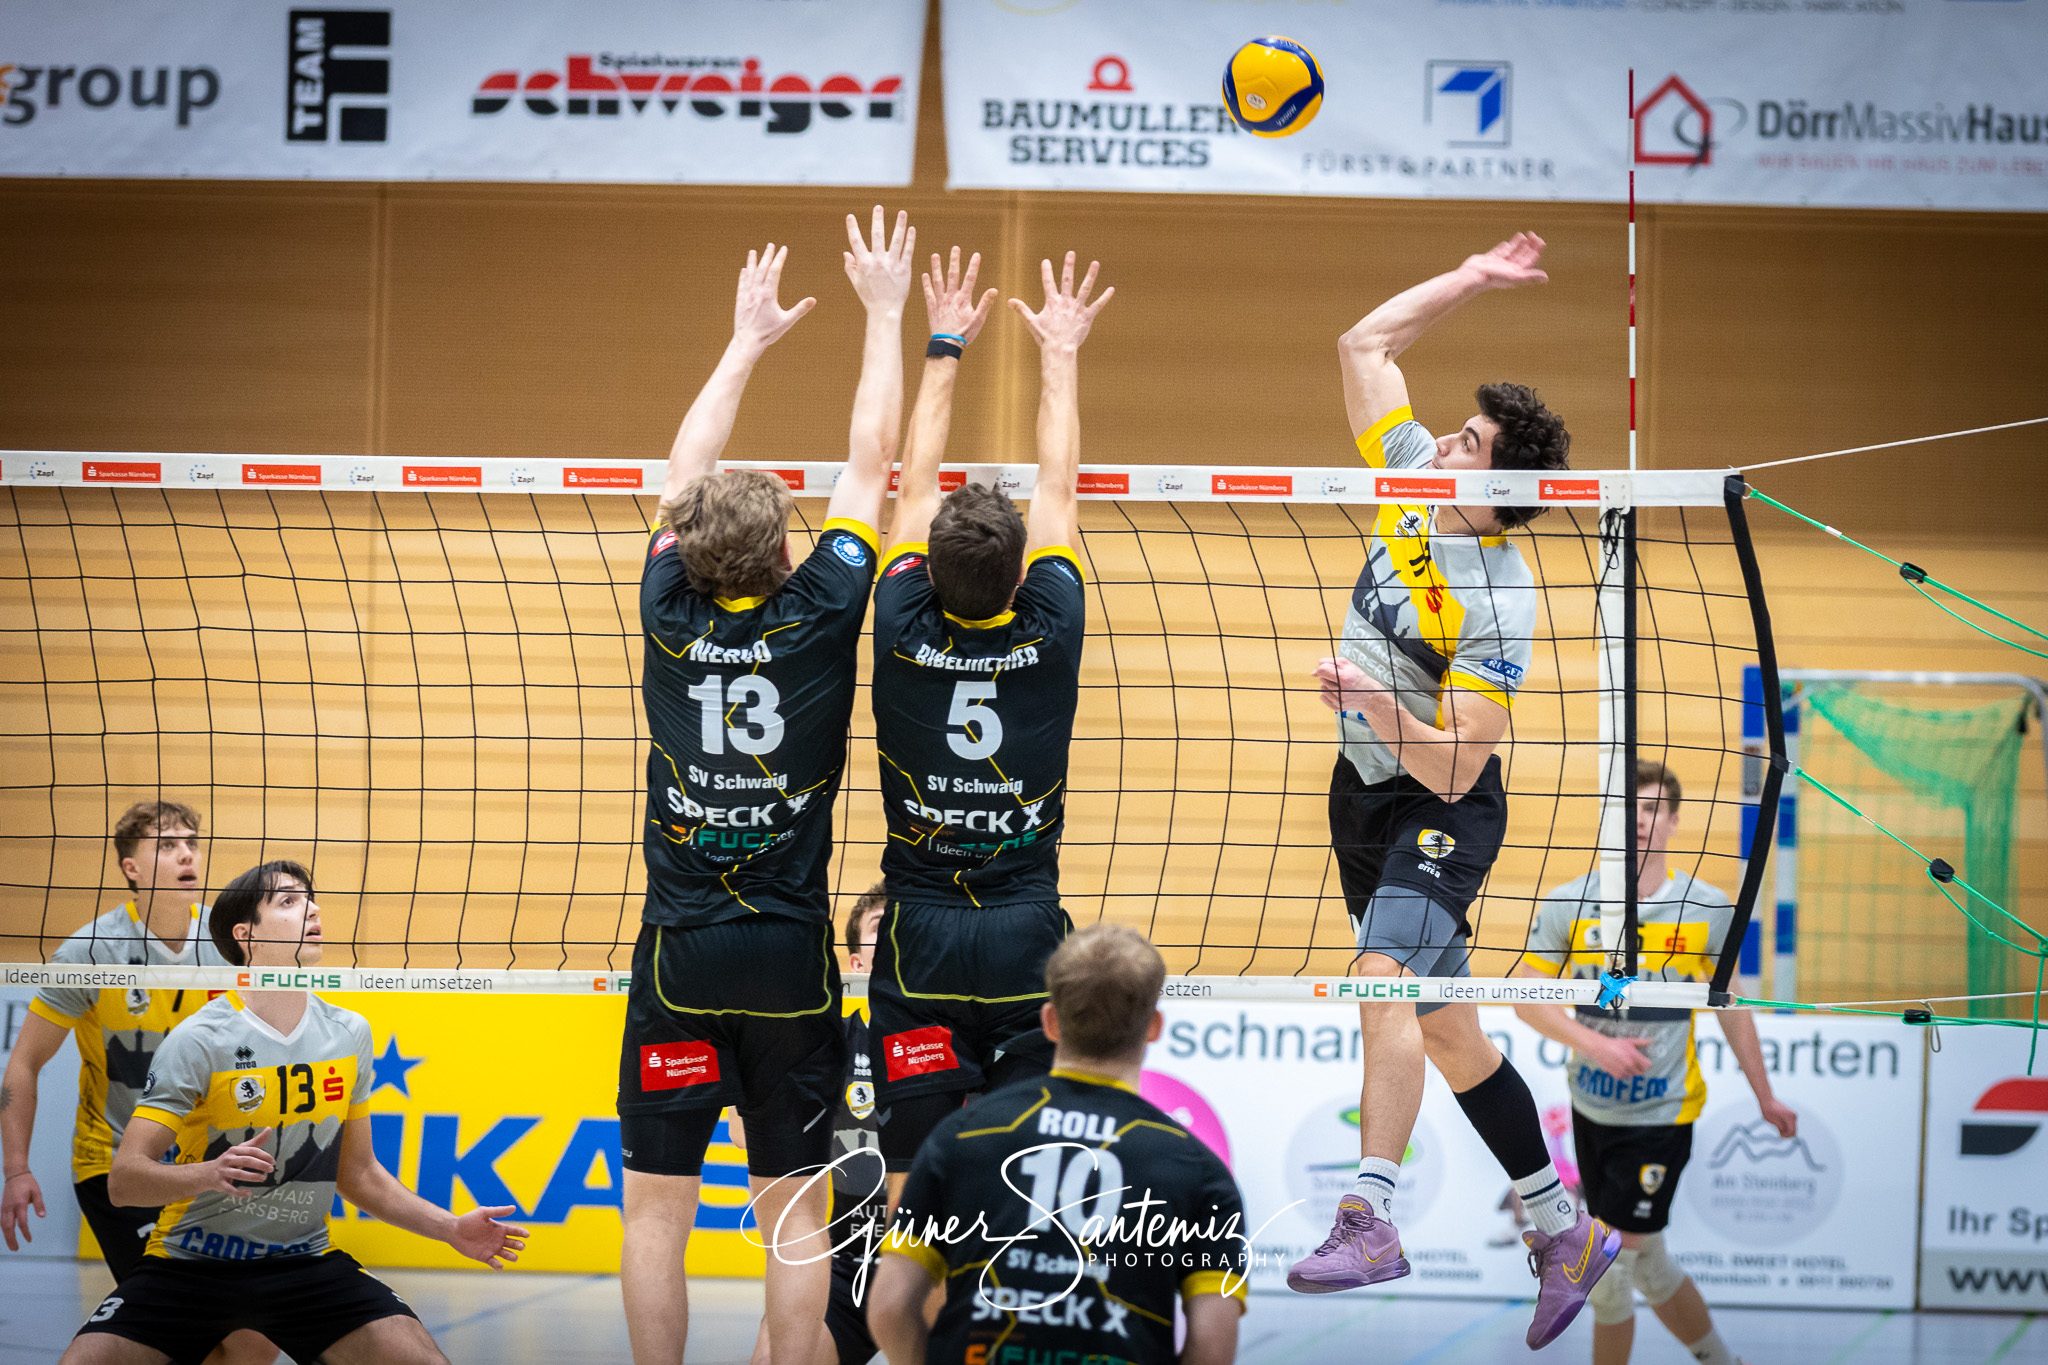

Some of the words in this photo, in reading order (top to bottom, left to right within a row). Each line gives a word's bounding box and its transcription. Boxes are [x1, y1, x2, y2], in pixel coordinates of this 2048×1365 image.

[294, 18, 326, 134] TEAM
[472, 54, 904, 134] schweiger
[1008, 135, 1210, 168] SERVICES
[37, 470, 54, 478] Zapf
[197, 472, 214, 481] Zapf
[357, 474, 374, 483] Zapf
[517, 476, 535, 484] Zapf
[1002, 481, 1020, 490] Zapf
[1165, 483, 1183, 491] Zapf
[1329, 485, 1346, 494] Zapf
[1492, 488, 1510, 496] Zapf
[688, 674, 785, 755] 13
[946, 680, 1004, 760] 5
[688, 765, 709, 788] SV
[713, 773, 788, 790] Schwaig
[927, 775, 948, 792] SV
[952, 777, 1024, 795] Schwaig
[667, 787, 778, 828] SPECK
[5, 968, 50, 984] Ideen
[55, 971, 137, 986] umsetzen
[261, 974, 341, 988] FUCHS
[360, 974, 405, 989] Ideen
[411, 975, 493, 990] umsetzen
[1339, 984, 1421, 998] FUCHS
[1439, 983, 1485, 998] Ideen
[1491, 985, 1576, 1000] umsetzen
[906, 1041, 943, 1055] Sparkasse
[235, 1060, 256, 1069] errea
[665, 1054, 708, 1067] Sparkasse
[907, 1052, 945, 1065] Nürnberg
[666, 1065, 706, 1077] Nürnberg
[277, 1063, 316, 1114] 13
[1037, 1107, 1120, 1143] ROLL
[1020, 1146, 1123, 1238] 10
[1949, 1206, 1996, 1235] Ihr
[1008, 1249, 1033, 1270] SV
[1948, 1266, 2048, 1294] ww
[971, 1286, 1095, 1330] SPECK
